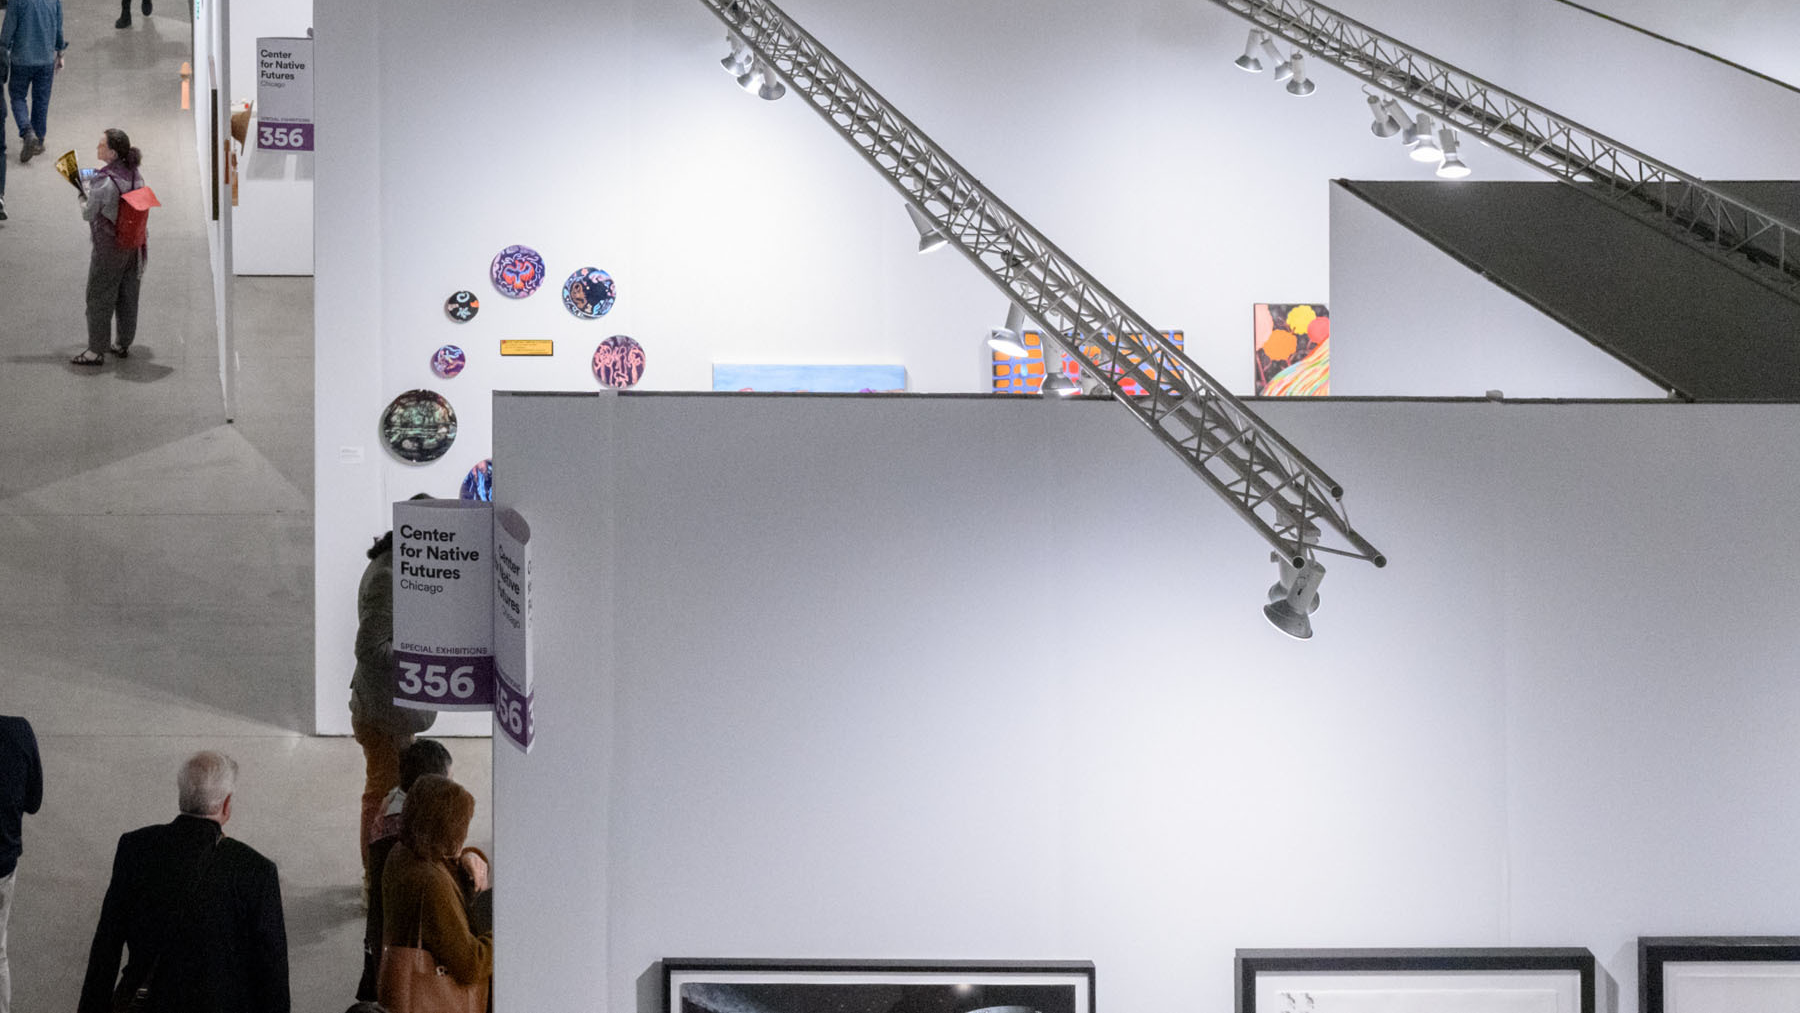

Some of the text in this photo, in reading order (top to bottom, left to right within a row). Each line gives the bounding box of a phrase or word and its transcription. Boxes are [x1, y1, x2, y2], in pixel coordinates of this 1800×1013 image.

[260, 49, 292, 59] Center
[260, 60, 306, 70] for Native
[260, 70, 295, 80] Futures
[260, 127, 304, 147] 356
[400, 524, 456, 542] Center
[400, 543, 480, 562] for Native
[400, 561, 461, 579] Futures
[400, 579, 444, 595] Chicago
[400, 642, 488, 655] SPECIAL EXHIBITIONS
[398, 660, 476, 699] 356
